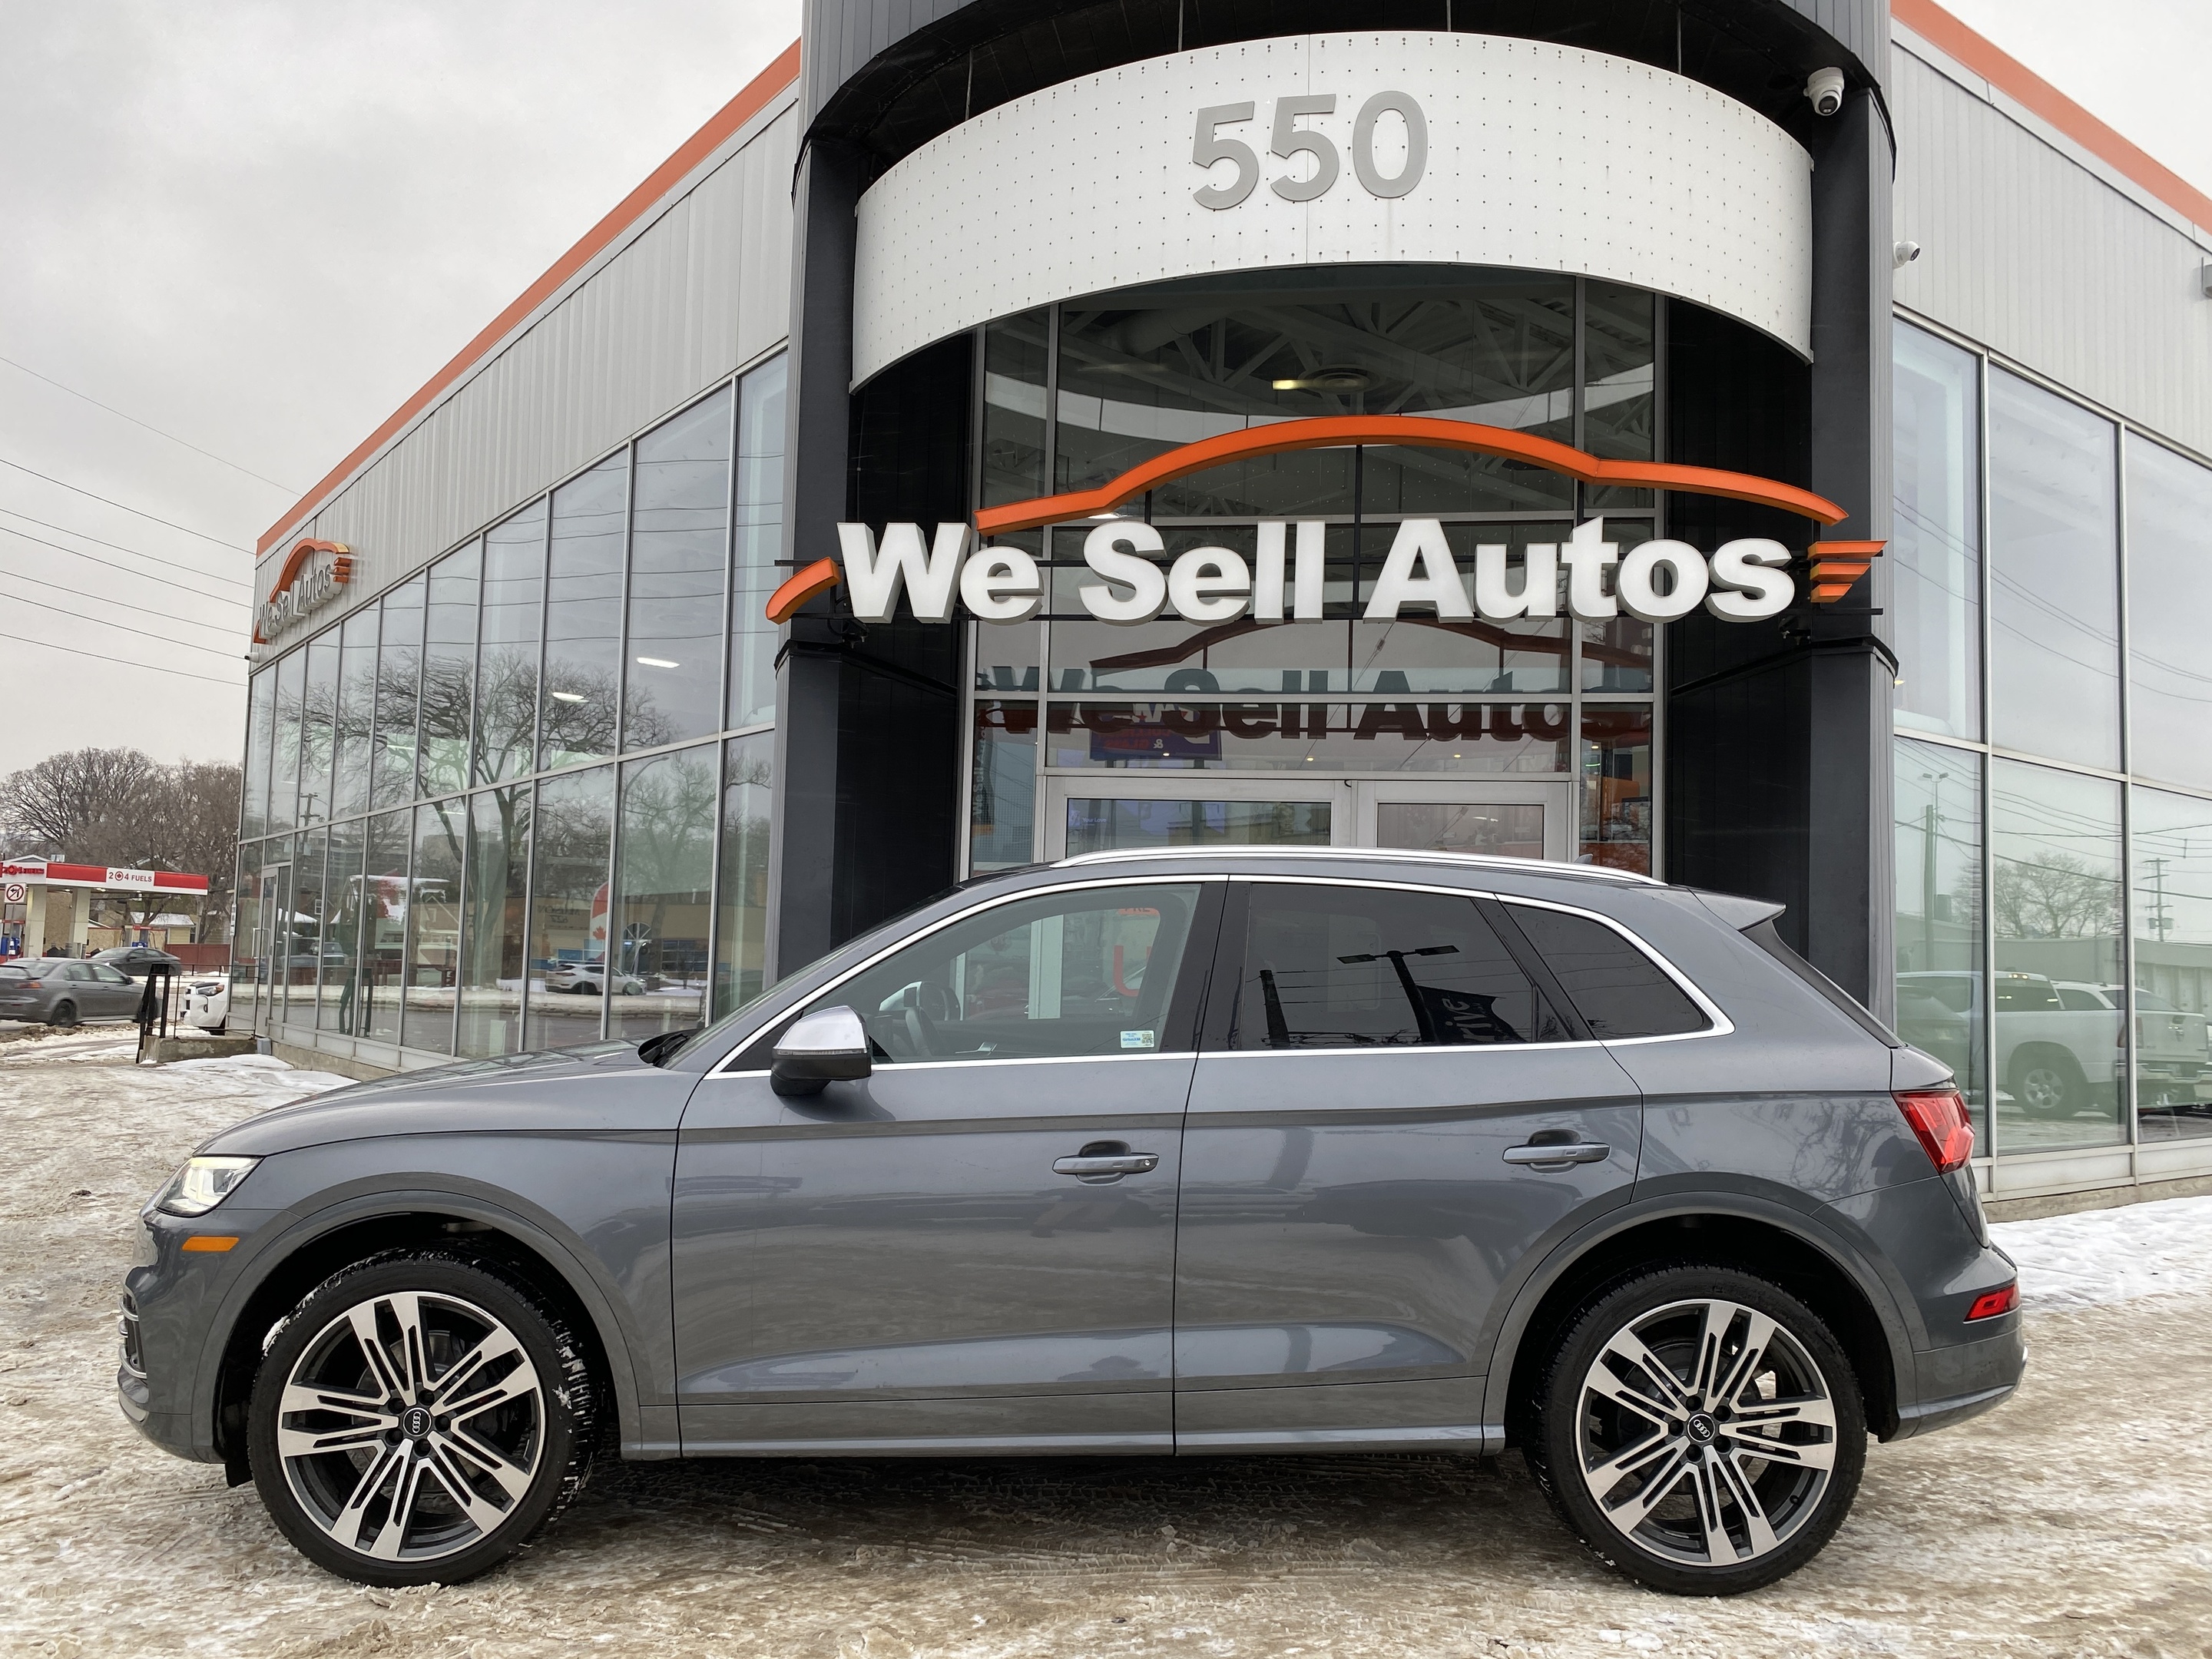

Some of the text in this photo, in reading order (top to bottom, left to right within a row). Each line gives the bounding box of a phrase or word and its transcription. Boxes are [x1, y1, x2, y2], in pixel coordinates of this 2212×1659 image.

[1192, 91, 1428, 210] 550
[297, 564, 338, 614] Autos
[837, 515, 1795, 627] We Sell Autos
[131, 874, 152, 882] FUELS
